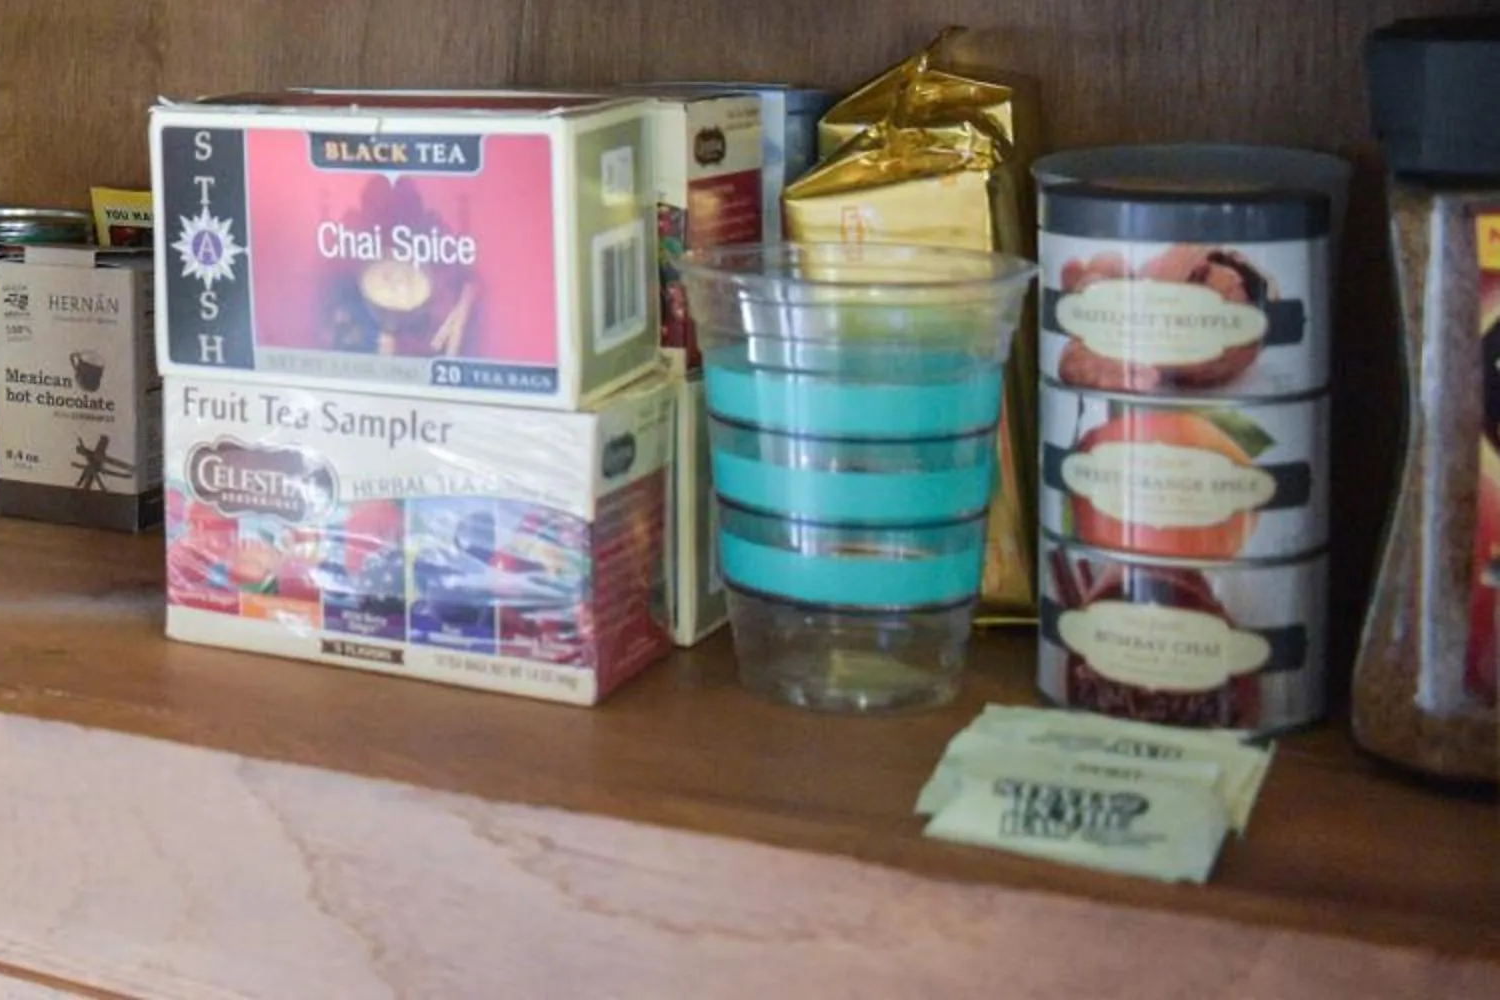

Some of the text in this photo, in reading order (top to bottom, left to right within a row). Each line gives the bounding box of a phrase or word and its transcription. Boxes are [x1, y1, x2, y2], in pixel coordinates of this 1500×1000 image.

[325, 141, 466, 165] BLACK TEA
[318, 221, 476, 273] Chai Spice
[4, 367, 73, 388] Mexican
[435, 363, 461, 384] 20
[508, 371, 552, 388] BAGS
[6, 387, 116, 412] hot chocolate
[183, 386, 453, 449] Fruit Tea Sampler
[198, 454, 308, 499] CELESTI
